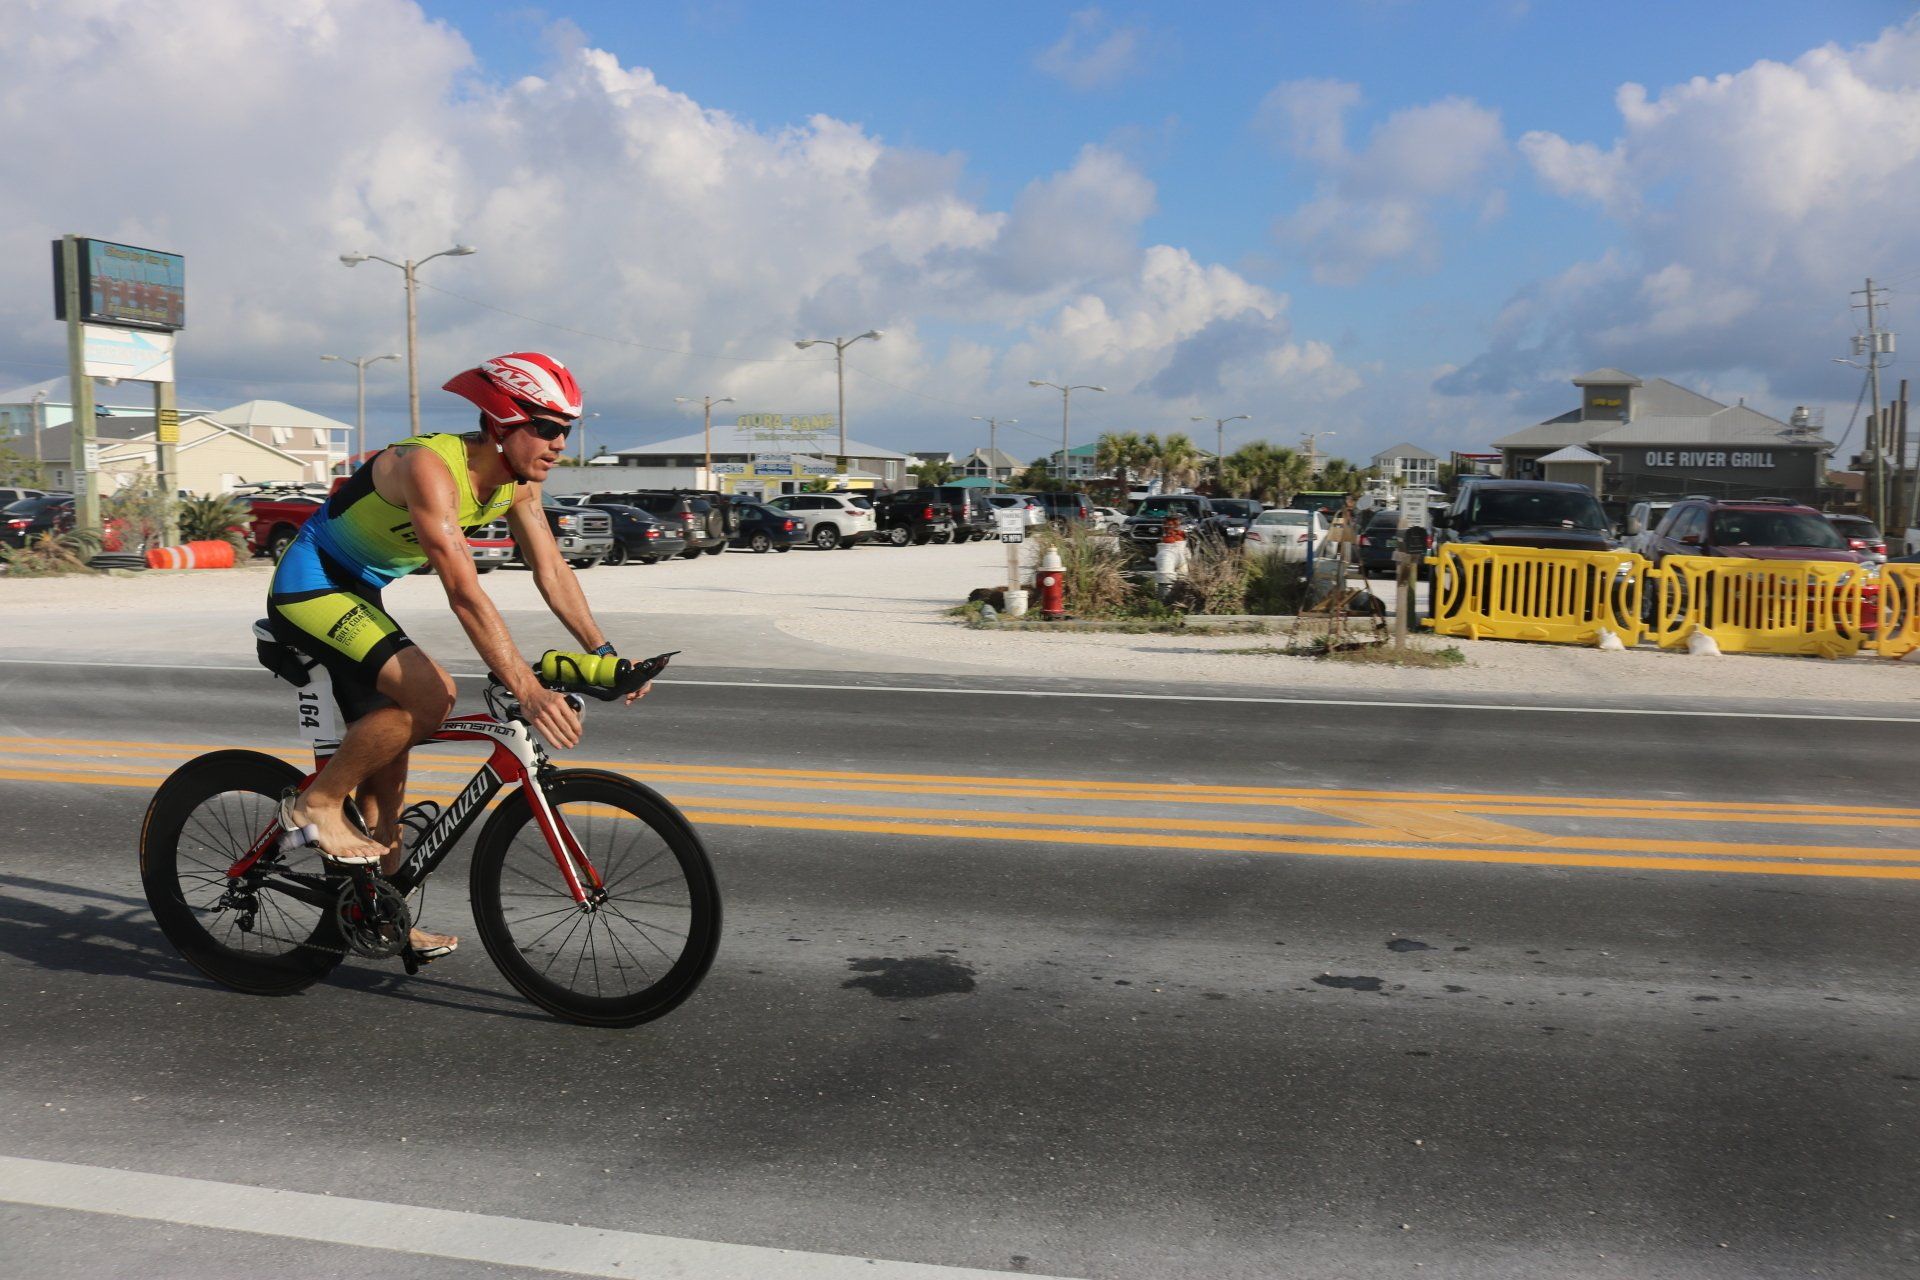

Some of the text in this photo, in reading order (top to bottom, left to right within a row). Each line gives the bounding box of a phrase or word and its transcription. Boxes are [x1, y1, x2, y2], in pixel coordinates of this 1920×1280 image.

[1645, 451, 1776, 468] OLE RIVER GRILL
[335, 609, 371, 643] GULF COAST
[345, 628, 362, 647] CYCLE
[298, 691, 320, 728] 164
[409, 771, 489, 877] SPECIALIZED
